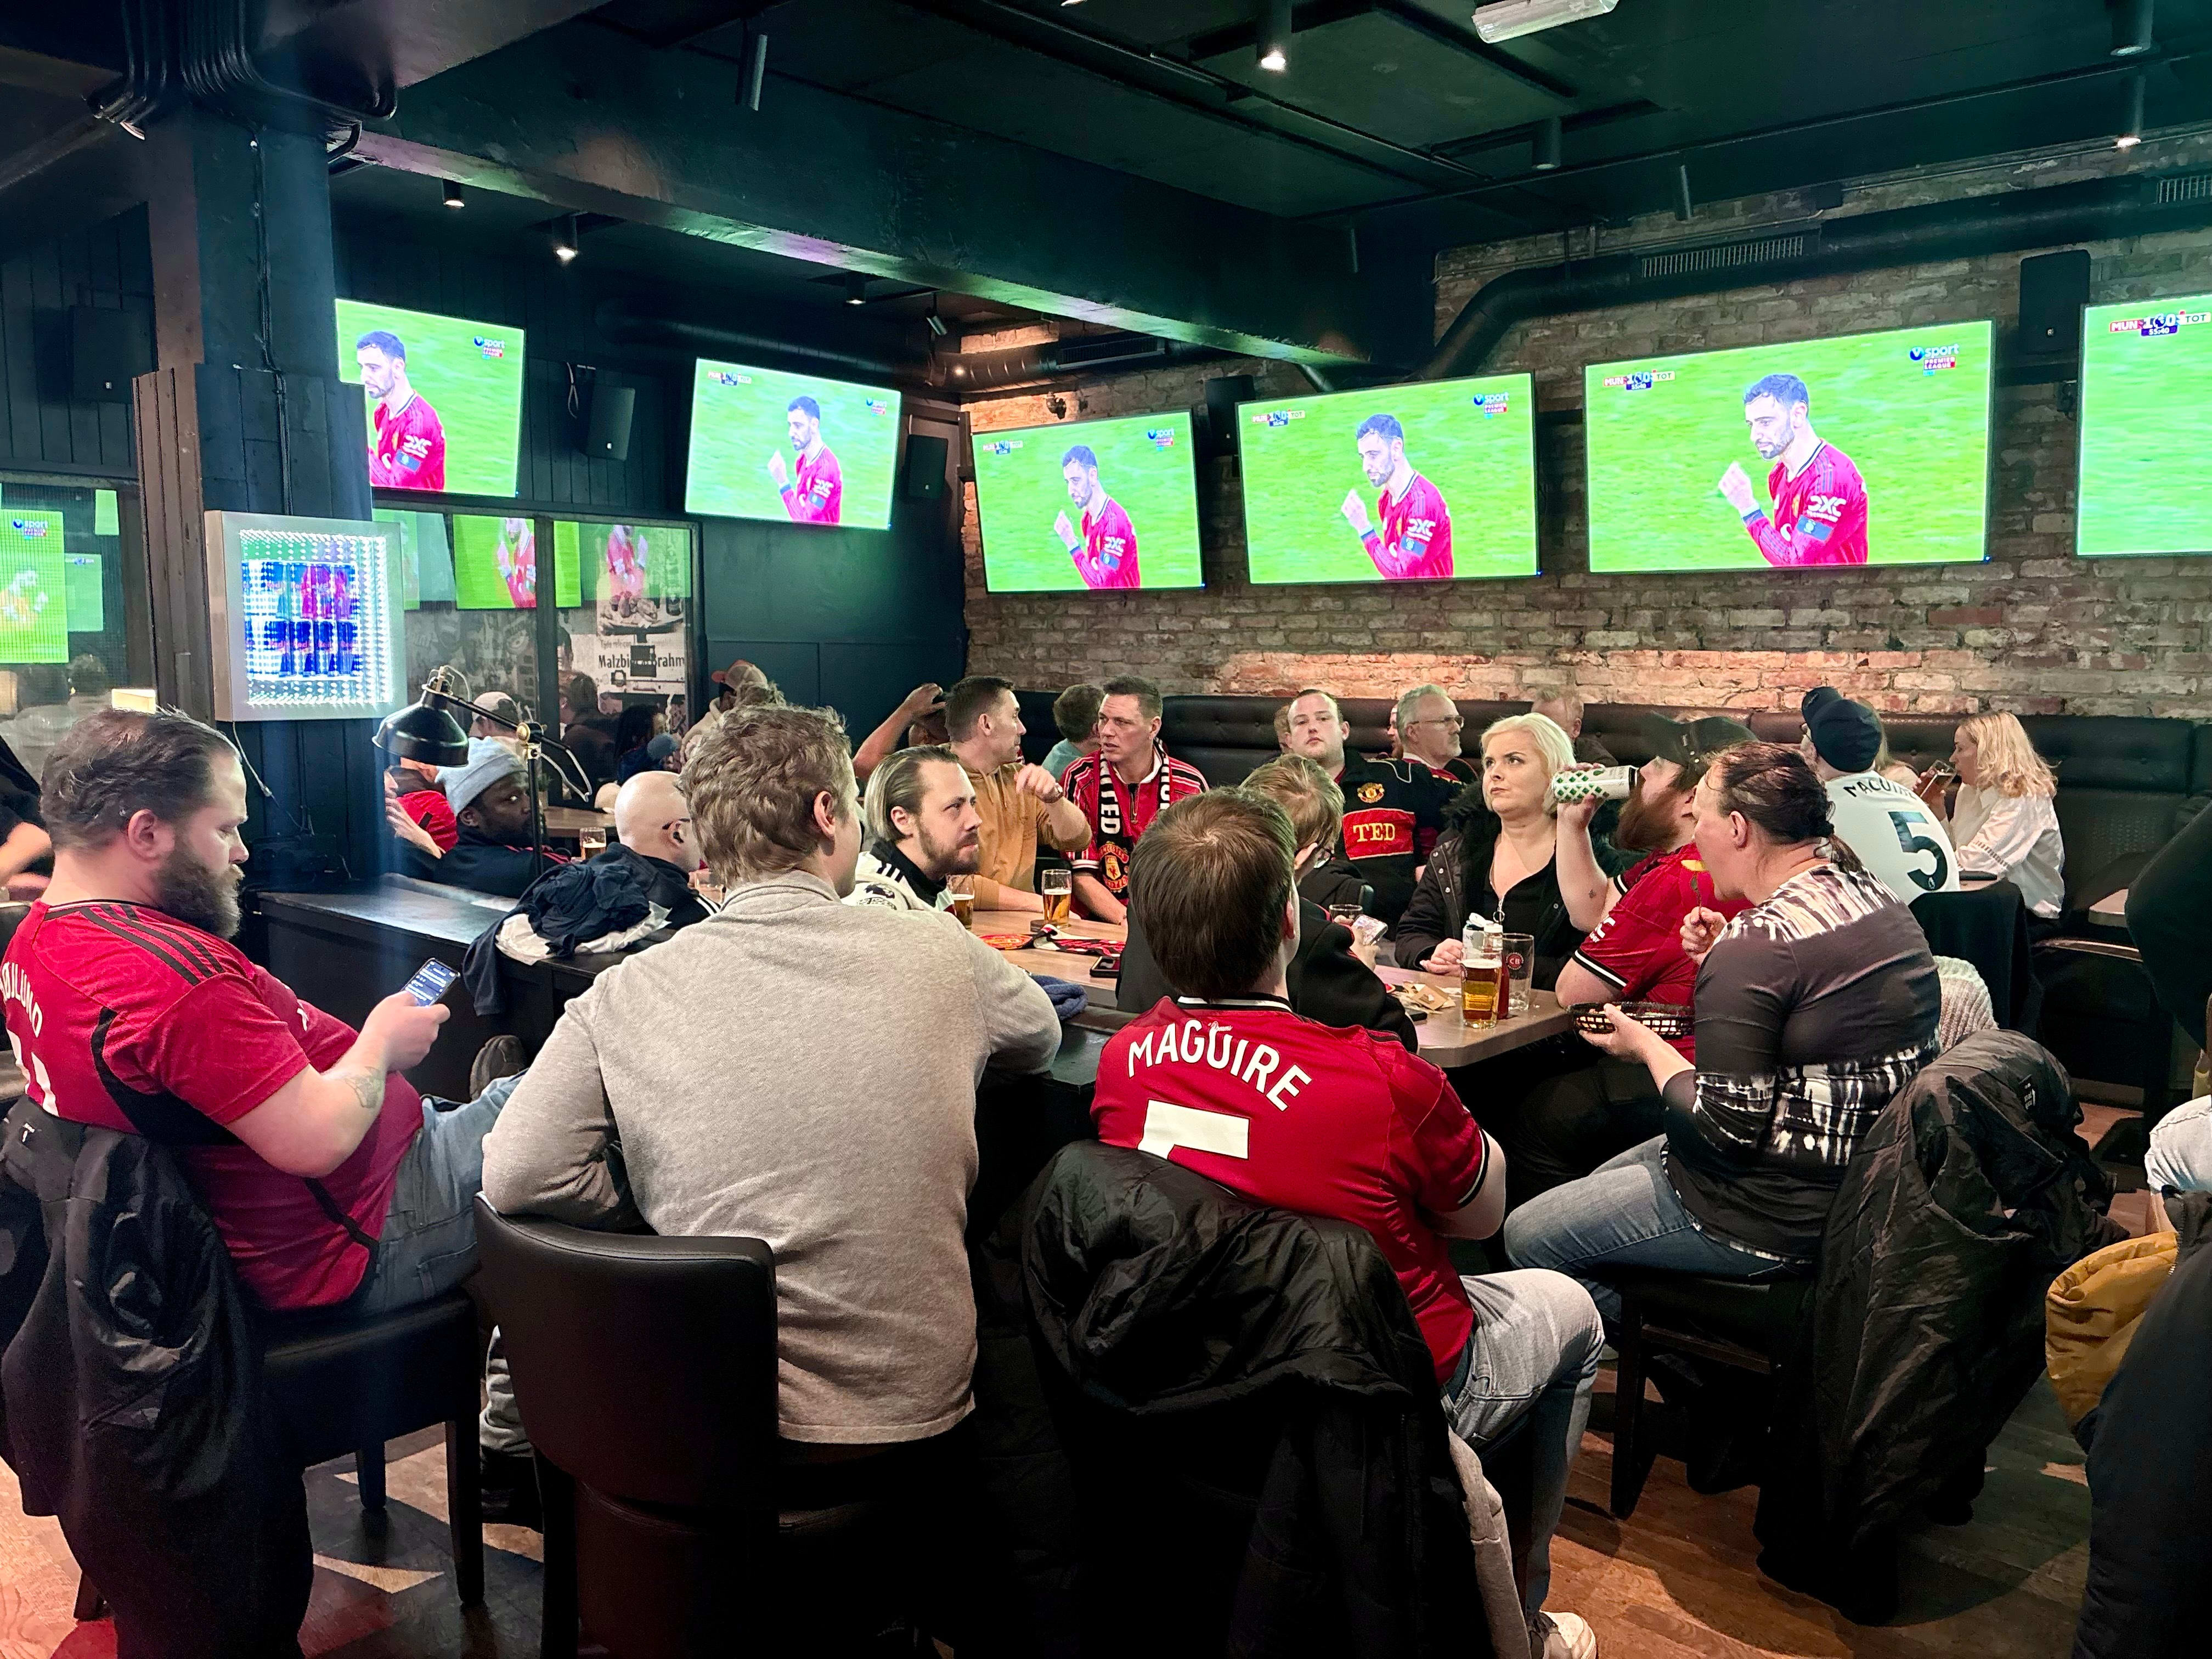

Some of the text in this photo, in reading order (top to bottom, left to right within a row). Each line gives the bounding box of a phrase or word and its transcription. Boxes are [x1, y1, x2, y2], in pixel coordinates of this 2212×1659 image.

[2112, 313, 2207, 331] MUN 1 0 TOT
[2148, 327, 2170, 336] 55:40
[1925, 343, 1959, 358] sport
[1924, 357, 1955, 365] PREMIER
[1604, 377, 1624, 386] MUN
[1627, 374, 1634, 385] 1
[1643, 372, 1650, 383] 0
[1485, 392, 1509, 404] sport
[598, 653, 685, 669] Malzbi rahm
[1352, 822, 1396, 843] TED
[1888, 811, 1949, 891] 5
[0, 961, 43, 1039] ØJLUND
[1128, 1019, 1312, 1112] MAGUIRE
